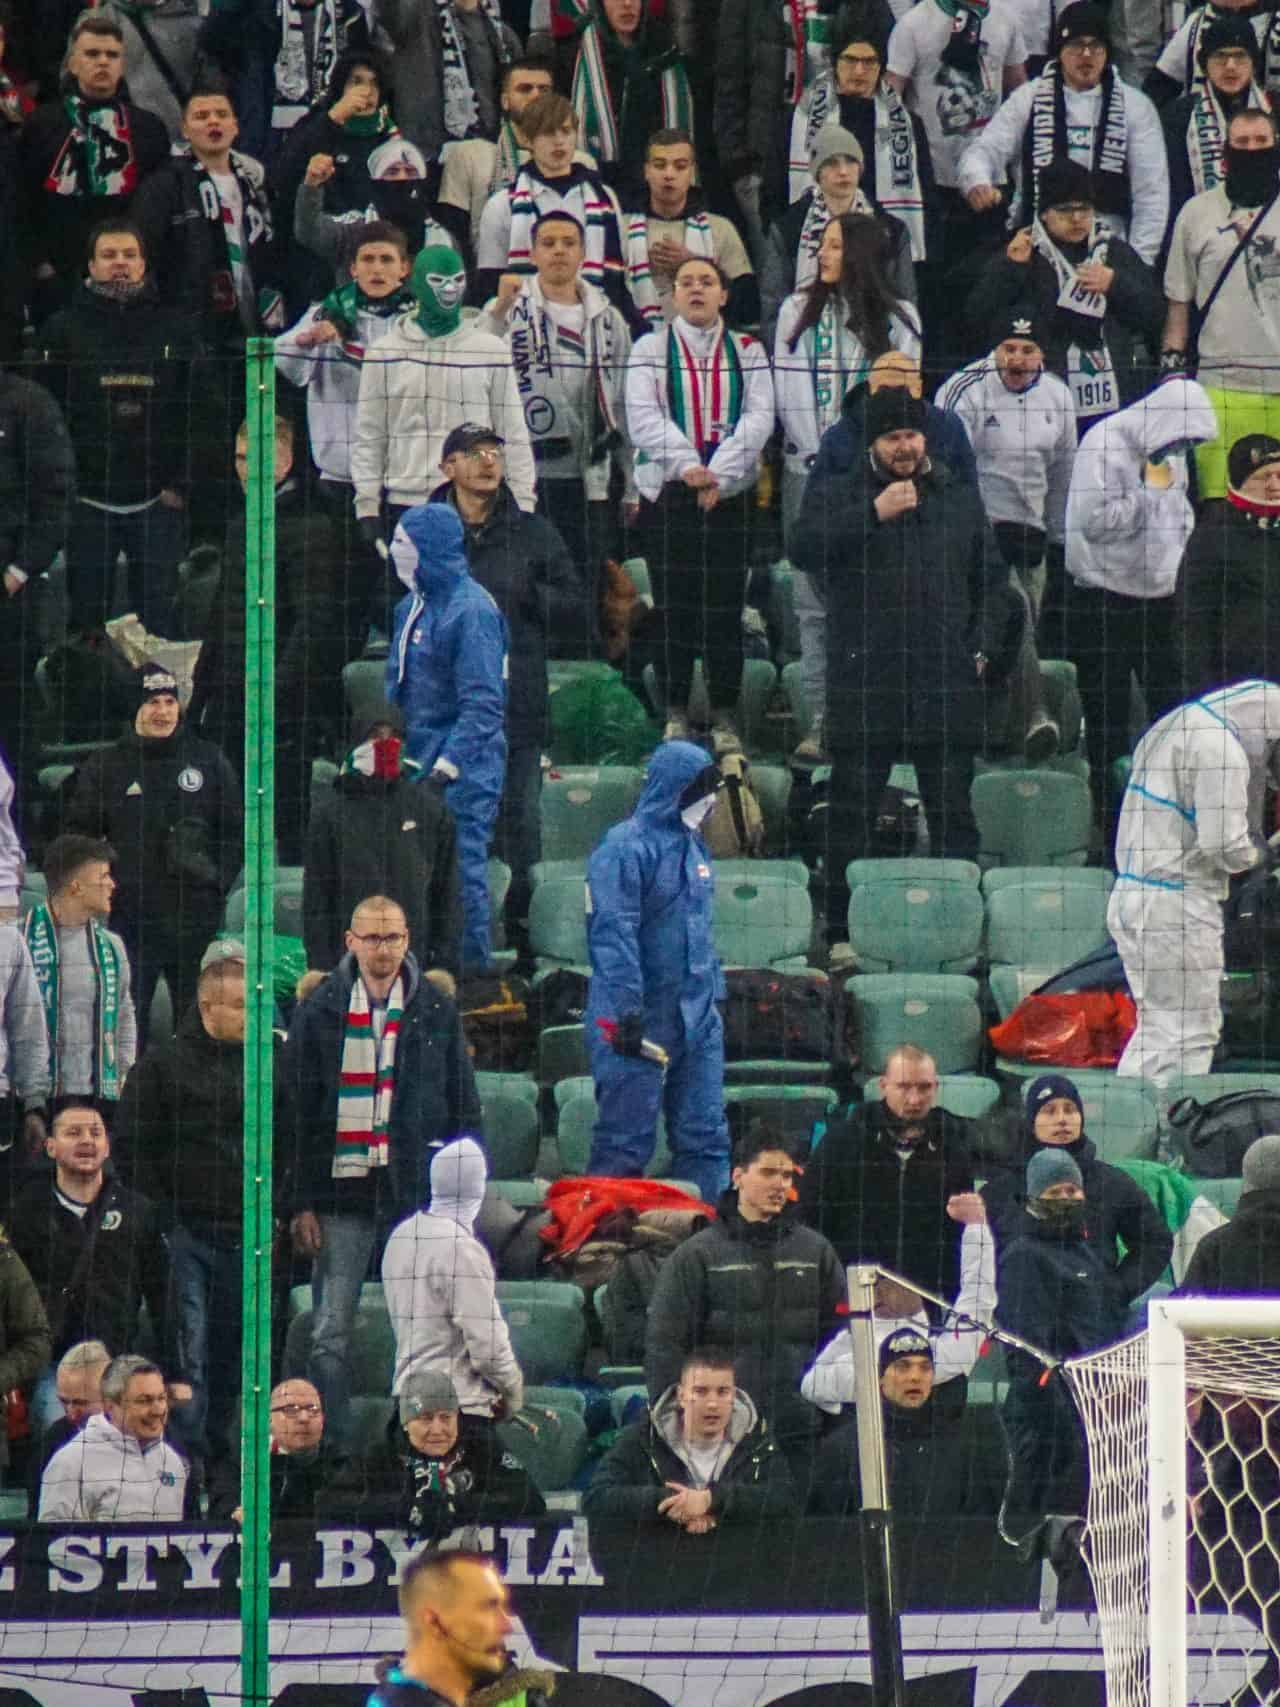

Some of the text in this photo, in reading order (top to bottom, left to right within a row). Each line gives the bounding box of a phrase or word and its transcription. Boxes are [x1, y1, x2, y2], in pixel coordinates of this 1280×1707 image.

[889, 104, 914, 190] LEGIA
[512, 329, 533, 393] WAMI
[1077, 381, 1112, 408] 1916
[315, 1527, 604, 1587] BYIA
